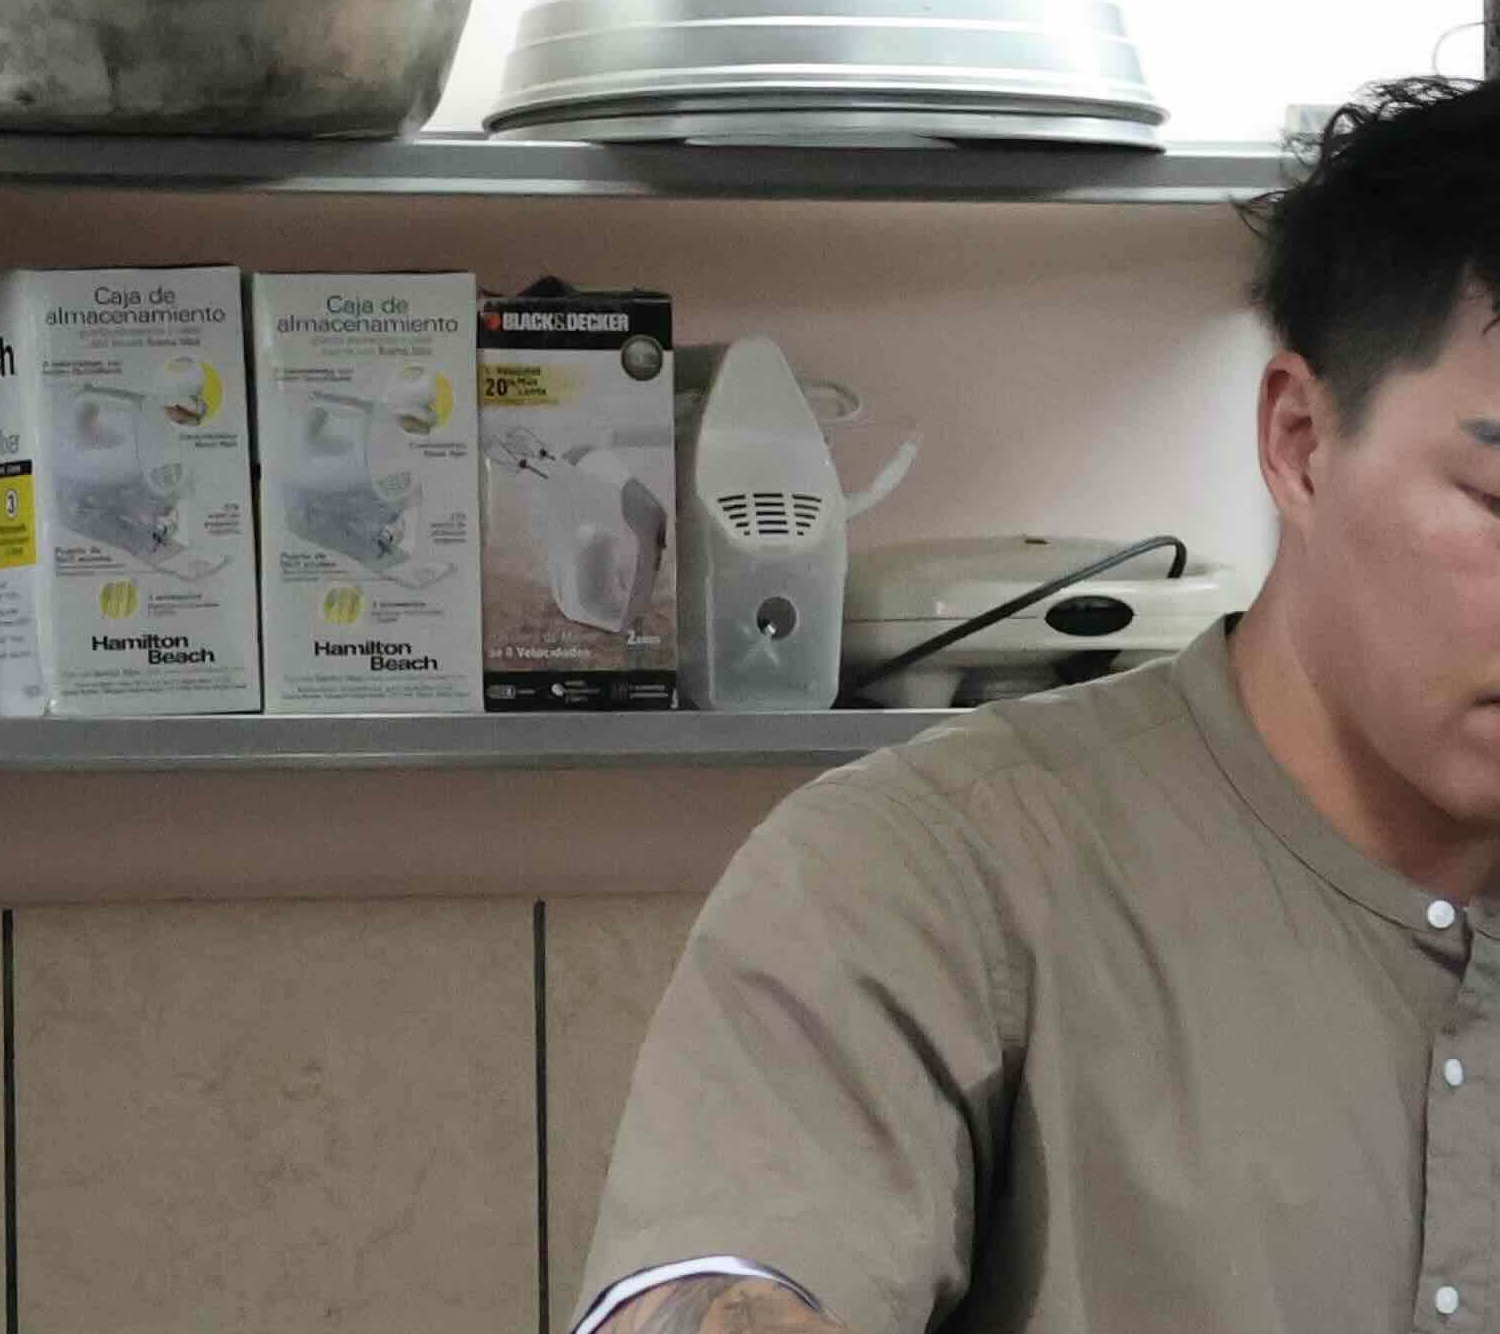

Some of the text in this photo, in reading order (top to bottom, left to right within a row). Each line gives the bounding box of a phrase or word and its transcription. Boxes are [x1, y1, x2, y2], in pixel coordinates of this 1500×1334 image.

[94, 286, 176, 308] Caja de
[326, 295, 409, 316] Caja de
[44, 307, 227, 326] almacenamiento
[276, 315, 459, 333] almacenamiento
[92, 633, 189, 651] Hamilton
[314, 640, 412, 656] Hamilton
[148, 648, 215, 665] Beach
[370, 656, 438, 671] Beach
